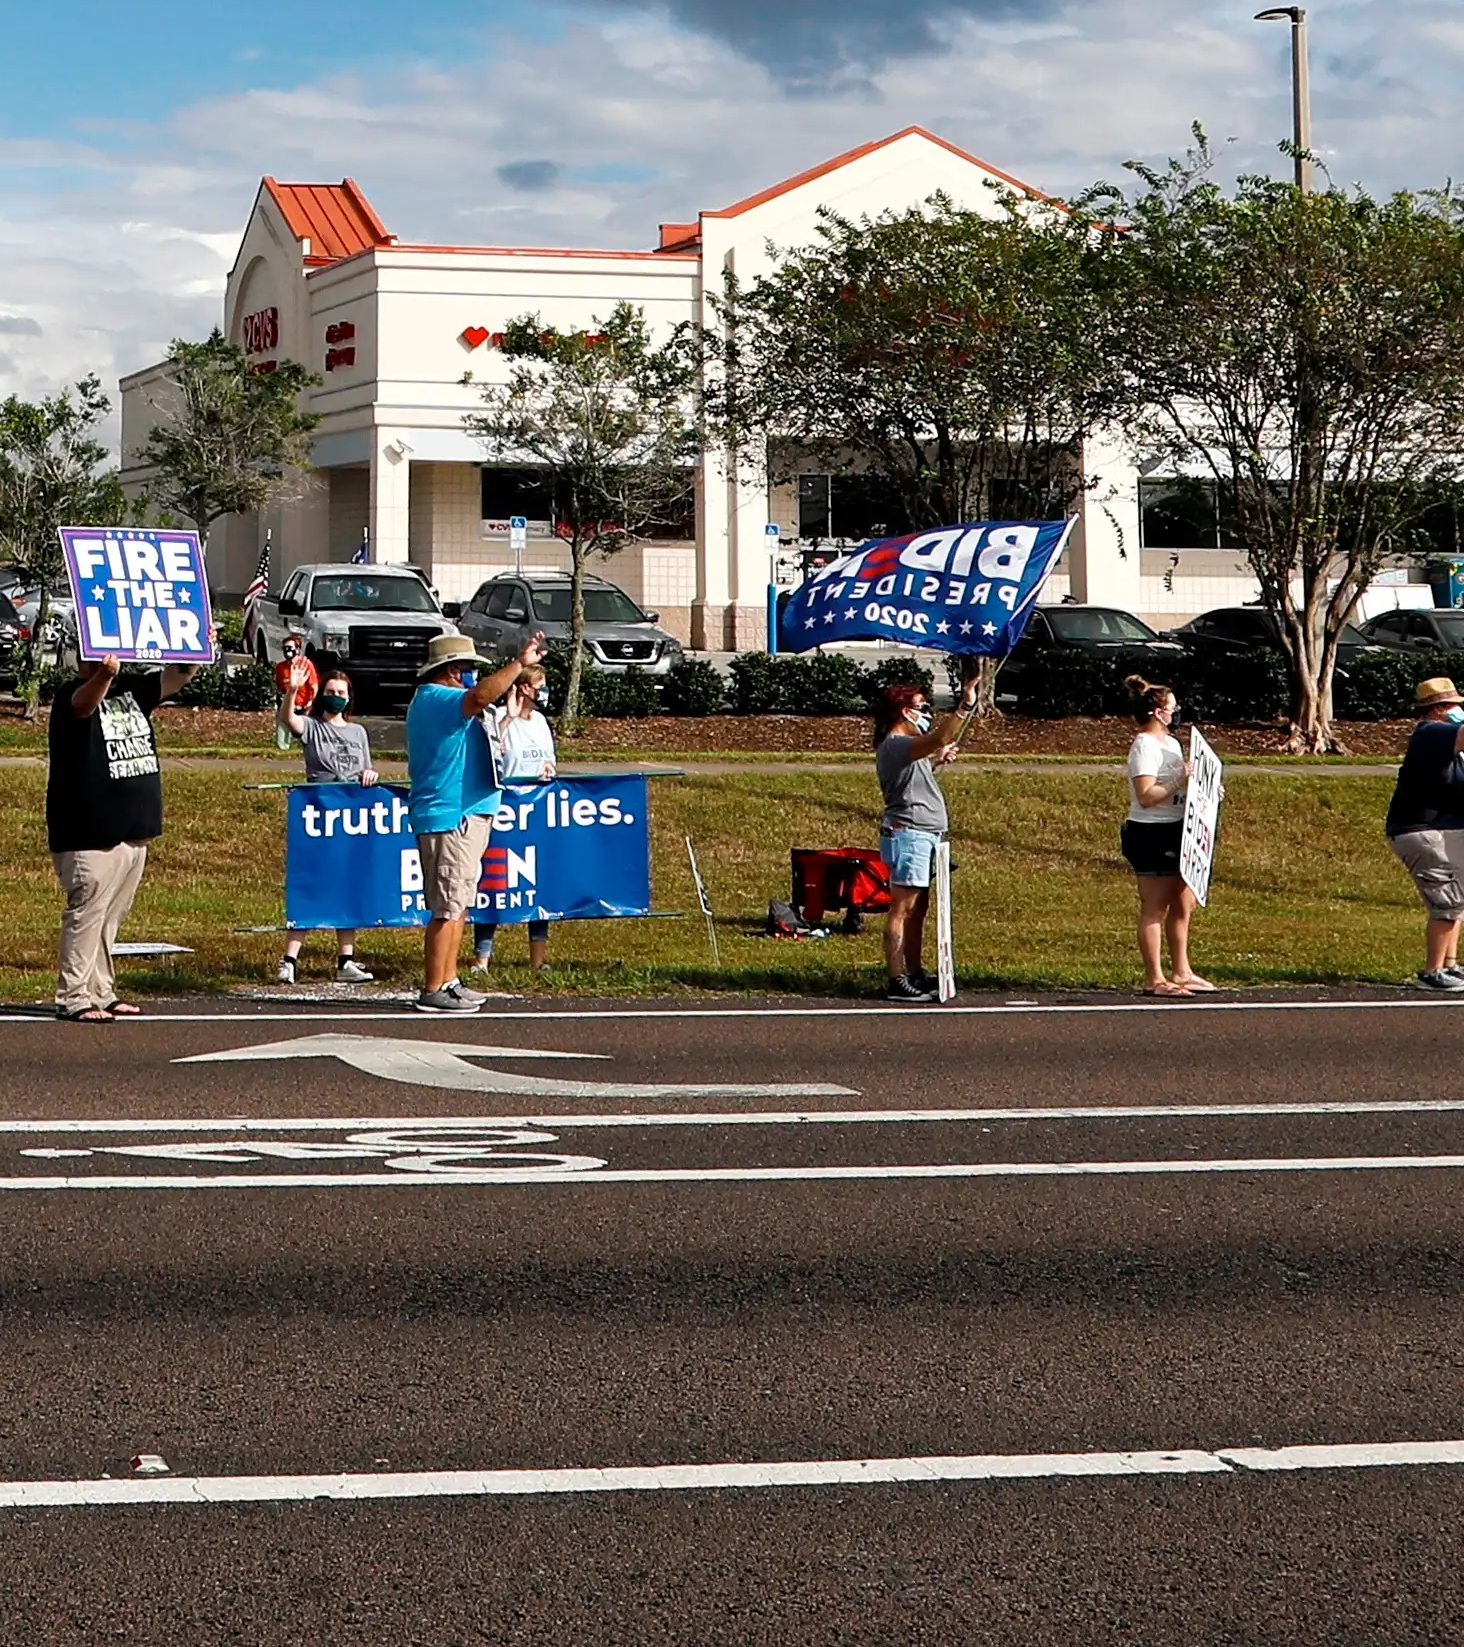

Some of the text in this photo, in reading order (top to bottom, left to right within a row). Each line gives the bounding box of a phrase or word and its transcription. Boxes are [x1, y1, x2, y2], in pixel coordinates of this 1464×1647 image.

[72, 539, 196, 582] FIRE
[106, 580, 177, 609] THE
[85, 605, 204, 651] LIAR
[135, 648, 163, 660] 2020
[547, 789, 635, 828] lies.
